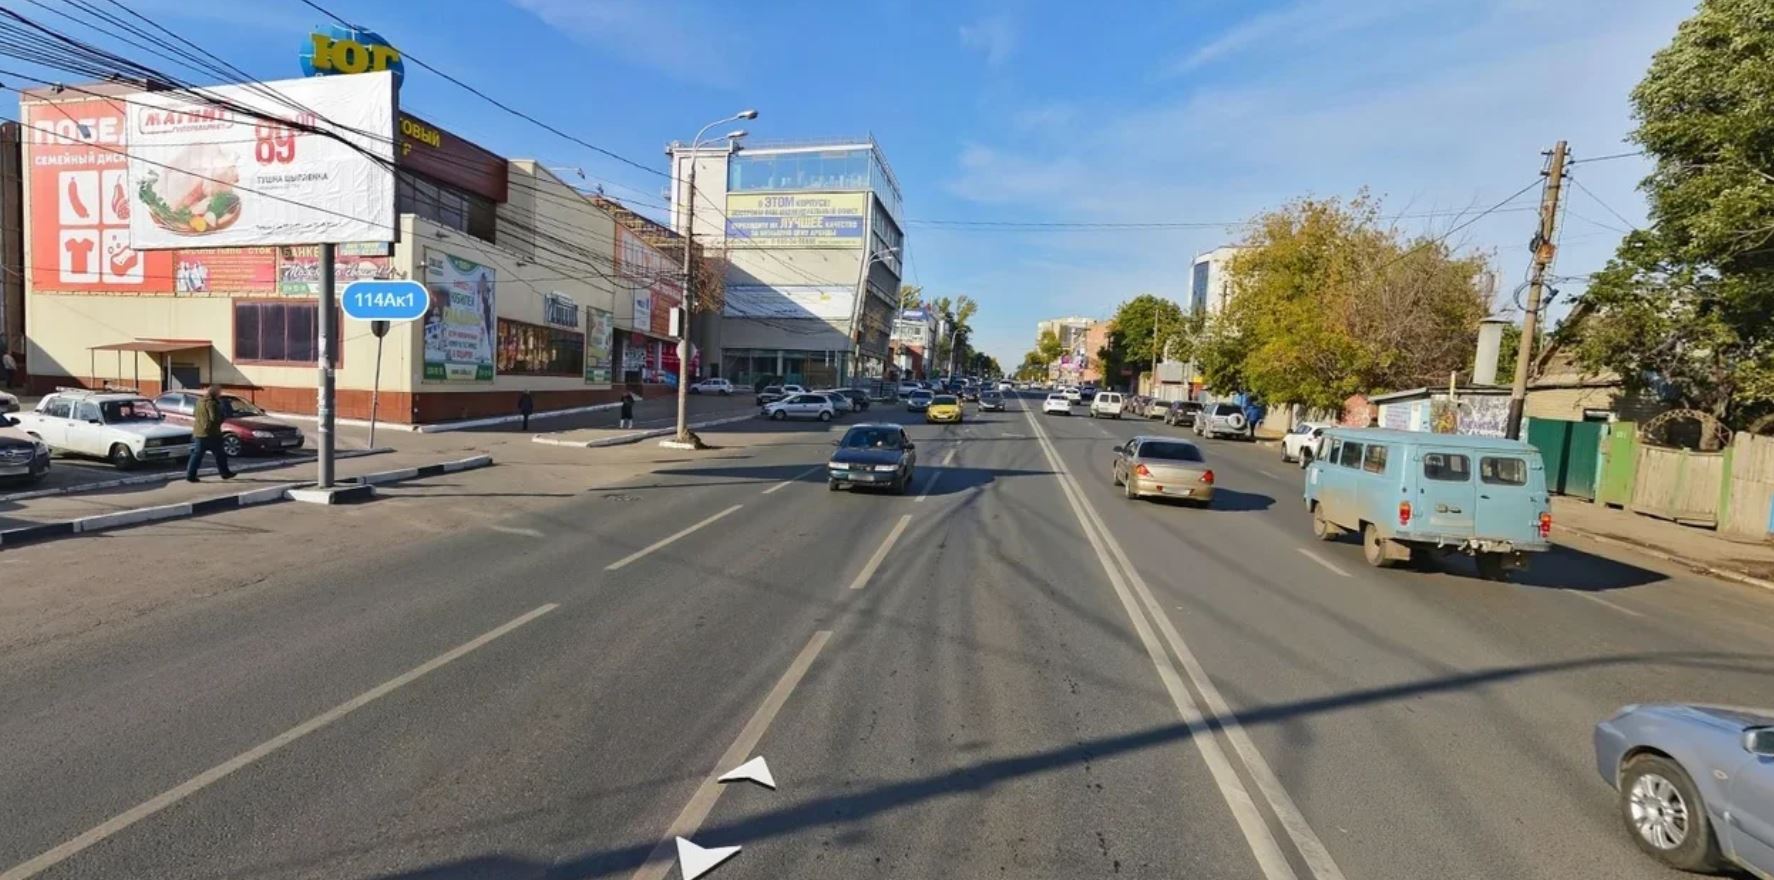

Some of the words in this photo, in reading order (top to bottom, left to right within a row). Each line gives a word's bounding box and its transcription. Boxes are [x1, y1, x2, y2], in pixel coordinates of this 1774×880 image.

[310, 33, 399, 73] ЮГ
[399, 117, 440, 147] ОВЫЙ
[35, 152, 95, 165] СЕМЕЙНЫЙ
[256, 176, 283, 185] ТУШКА
[765, 197, 795, 208] ЭТОМ
[780, 217, 824, 229] ЛУЧШЕЕ
